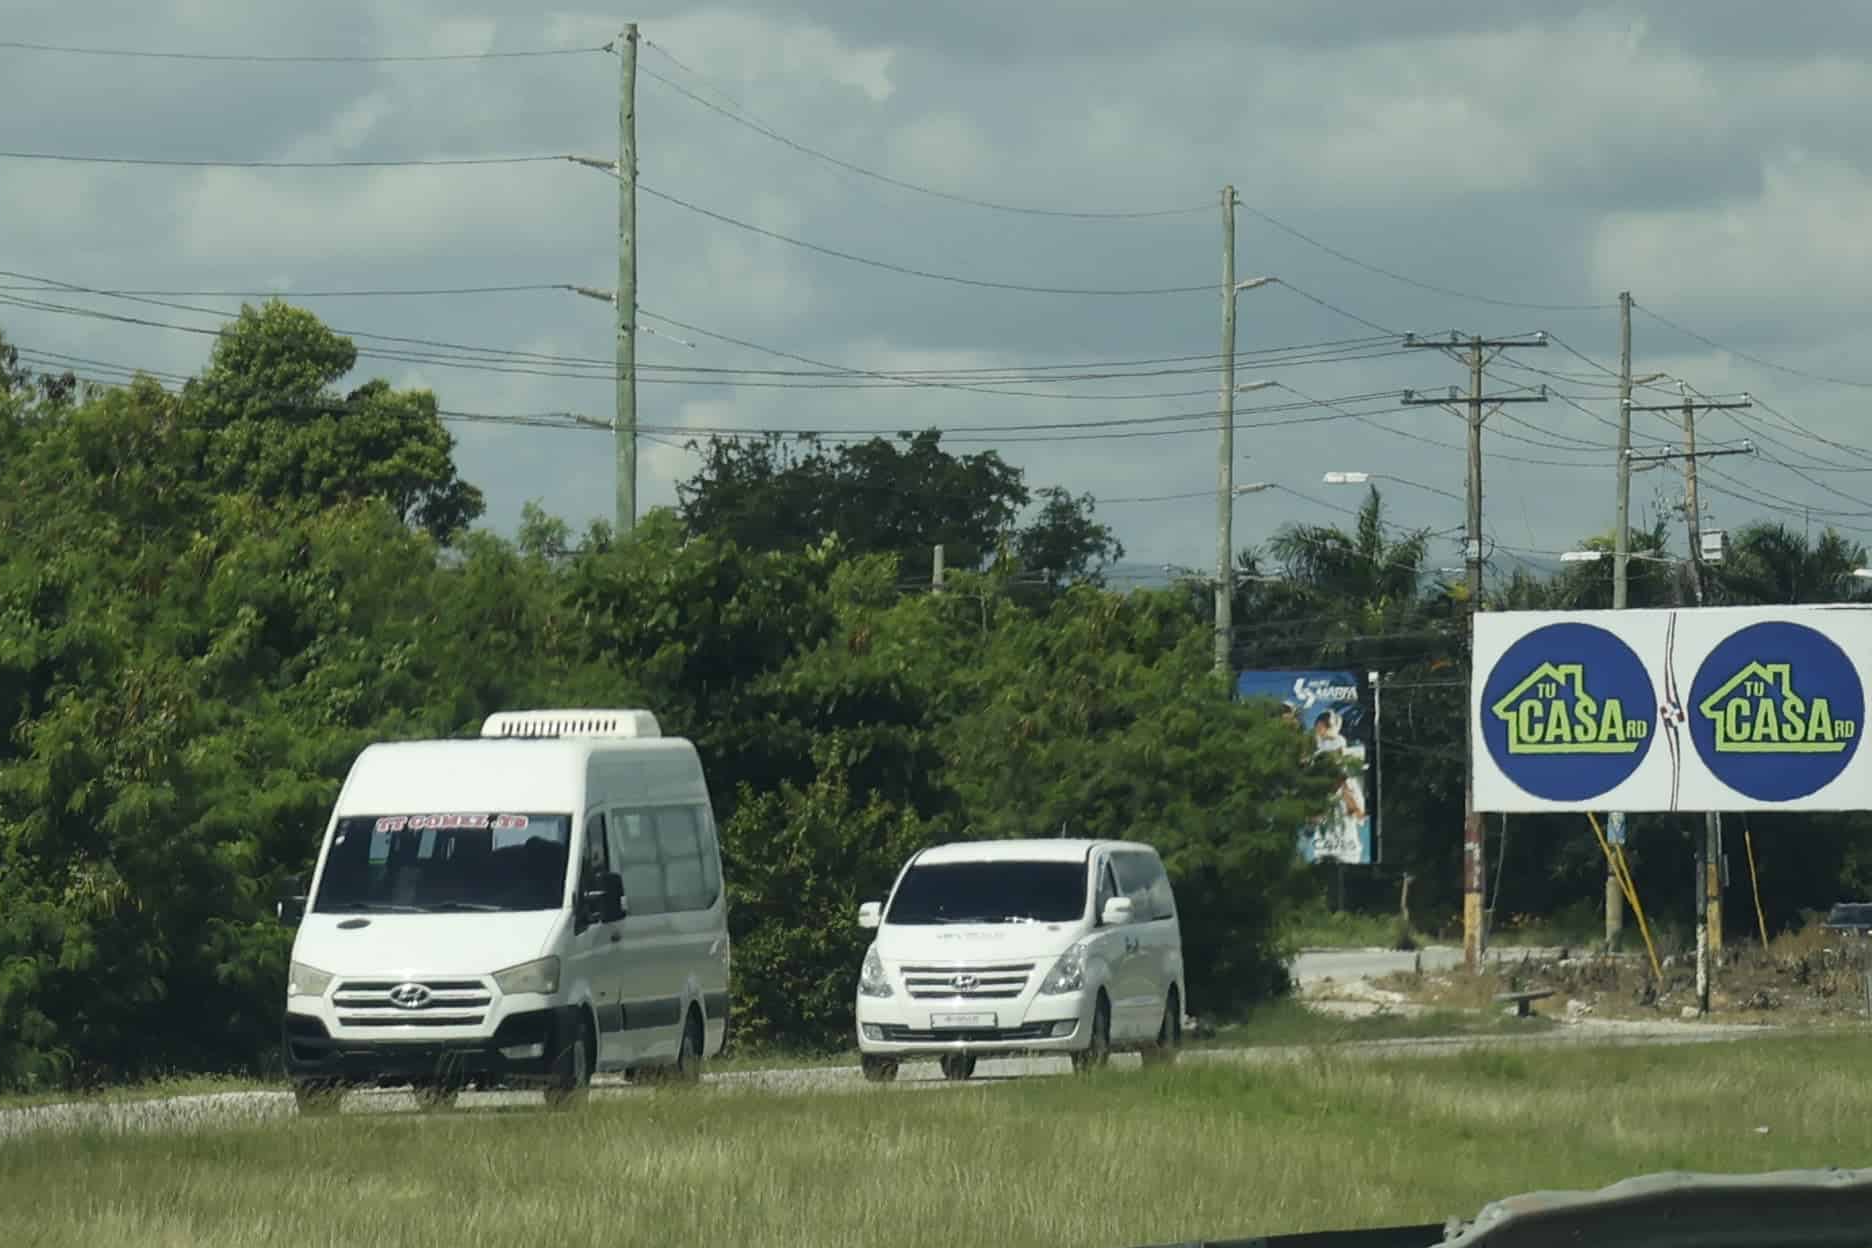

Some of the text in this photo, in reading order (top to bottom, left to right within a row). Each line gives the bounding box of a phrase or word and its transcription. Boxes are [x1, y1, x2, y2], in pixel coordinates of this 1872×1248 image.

[1538, 683, 1557, 699] TU
[1743, 681, 1765, 697] TU
[1518, 698, 1648, 743] CASA RD
[1726, 697, 1856, 742] CASA RD
